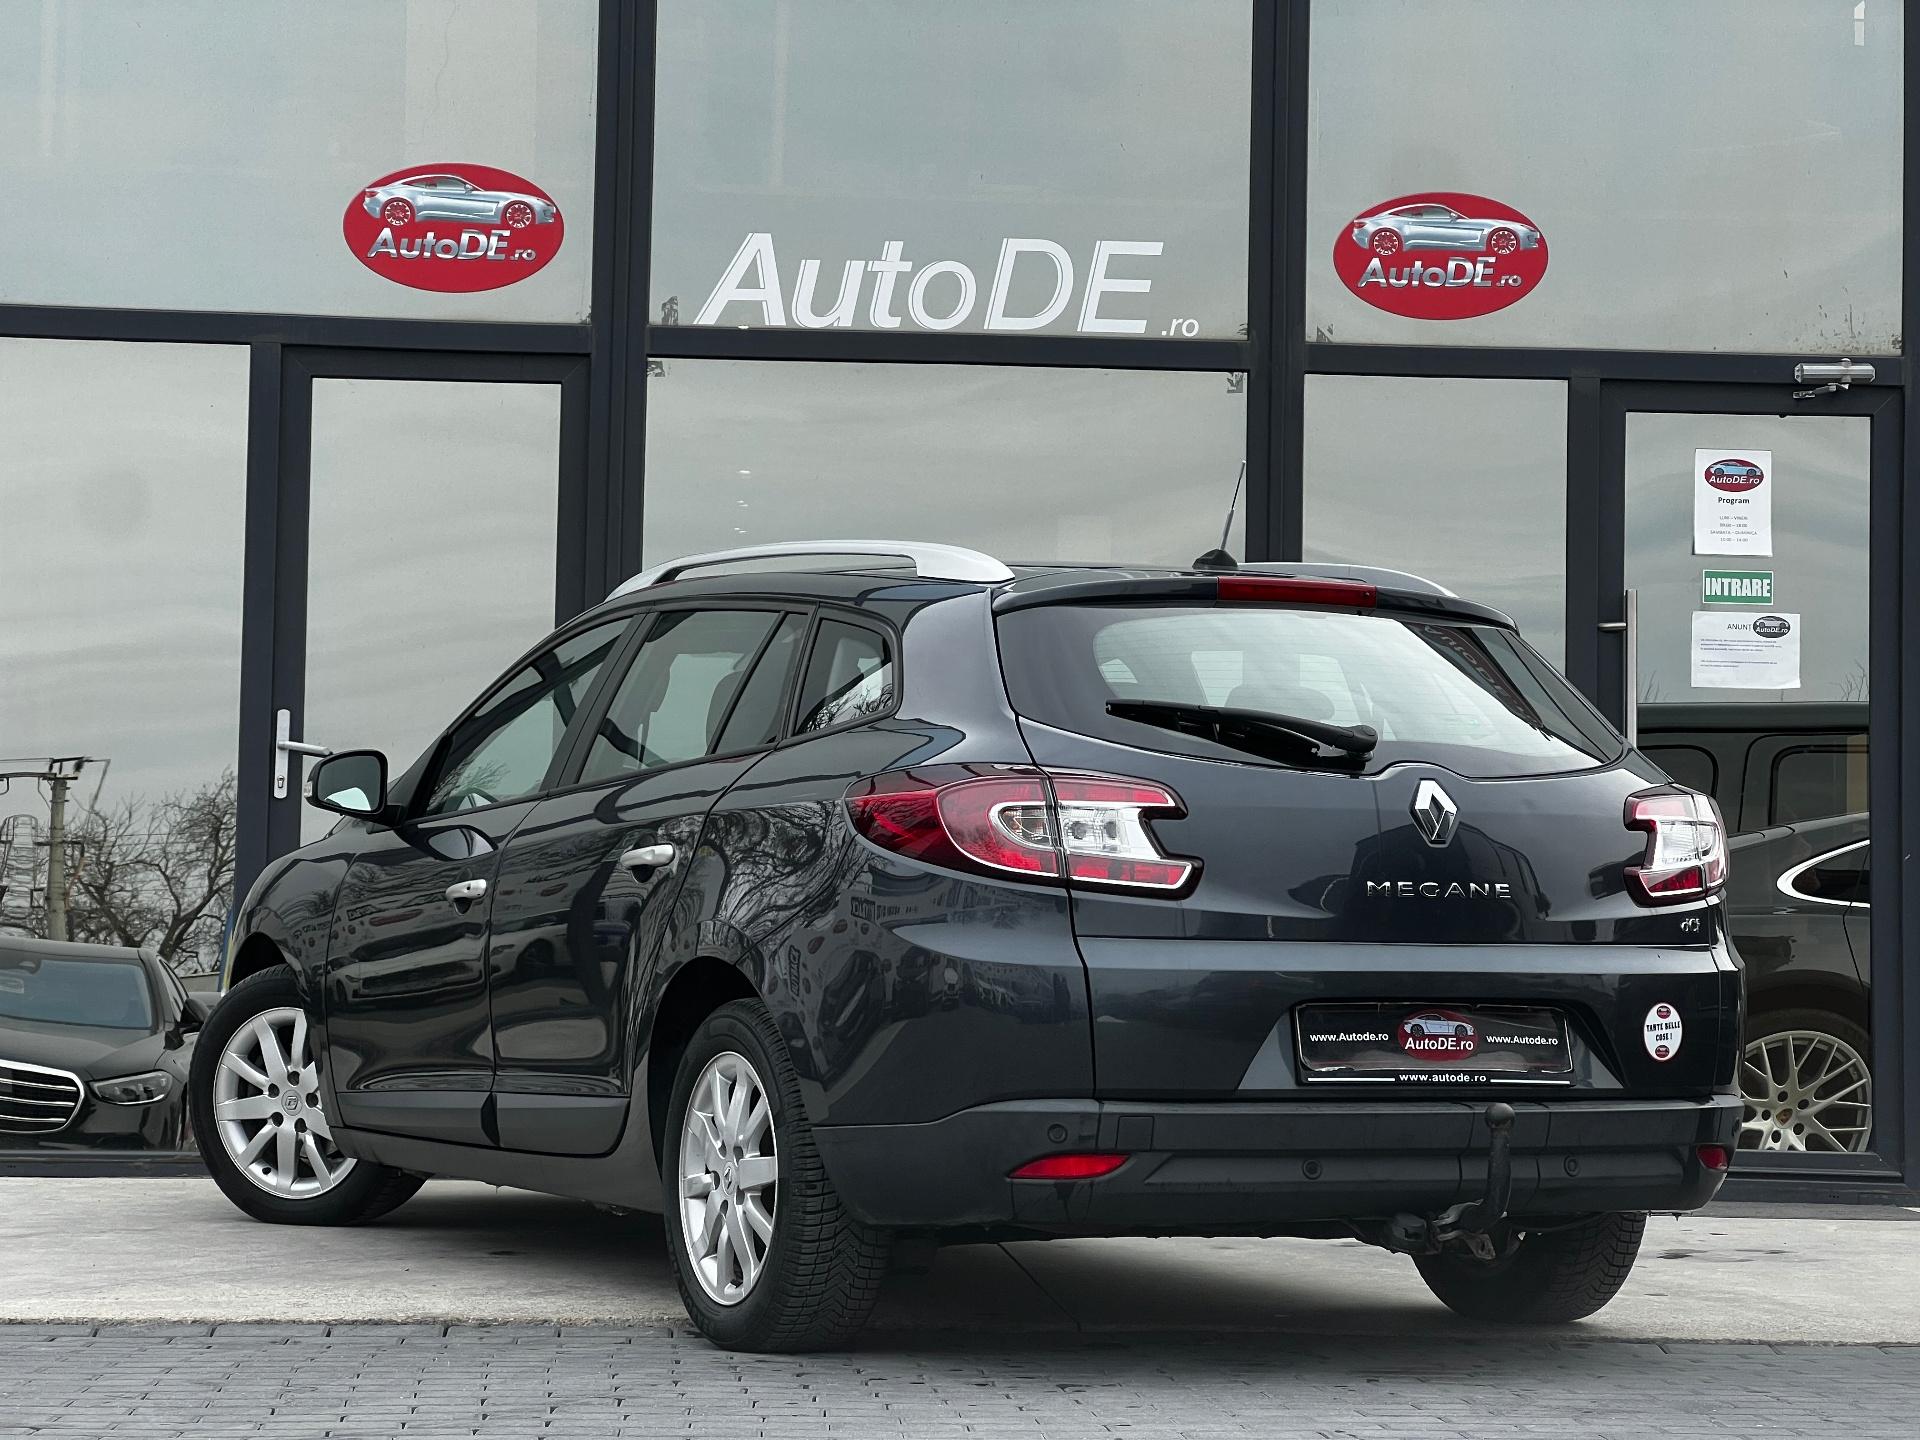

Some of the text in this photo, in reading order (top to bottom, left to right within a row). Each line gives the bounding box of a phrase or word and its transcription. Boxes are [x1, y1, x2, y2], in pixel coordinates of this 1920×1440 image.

[1709, 475, 1760, 485] AutoDE.ro
[1718, 496, 1750, 506] Program
[1705, 577, 1771, 597] INTRARE
[1366, 880, 1512, 899] MEGANE
[1646, 1021, 1681, 1032] TANTE BELLE
[1310, 1031, 1389, 1043] www.Autode.ro
[1486, 1033, 1559, 1046] www.Autode.ro
[1655, 1032, 1669, 1042] COSE
[1404, 1037, 1474, 1051] AutoDE.ro
[1399, 1072, 1487, 1083] www.autode.ro
